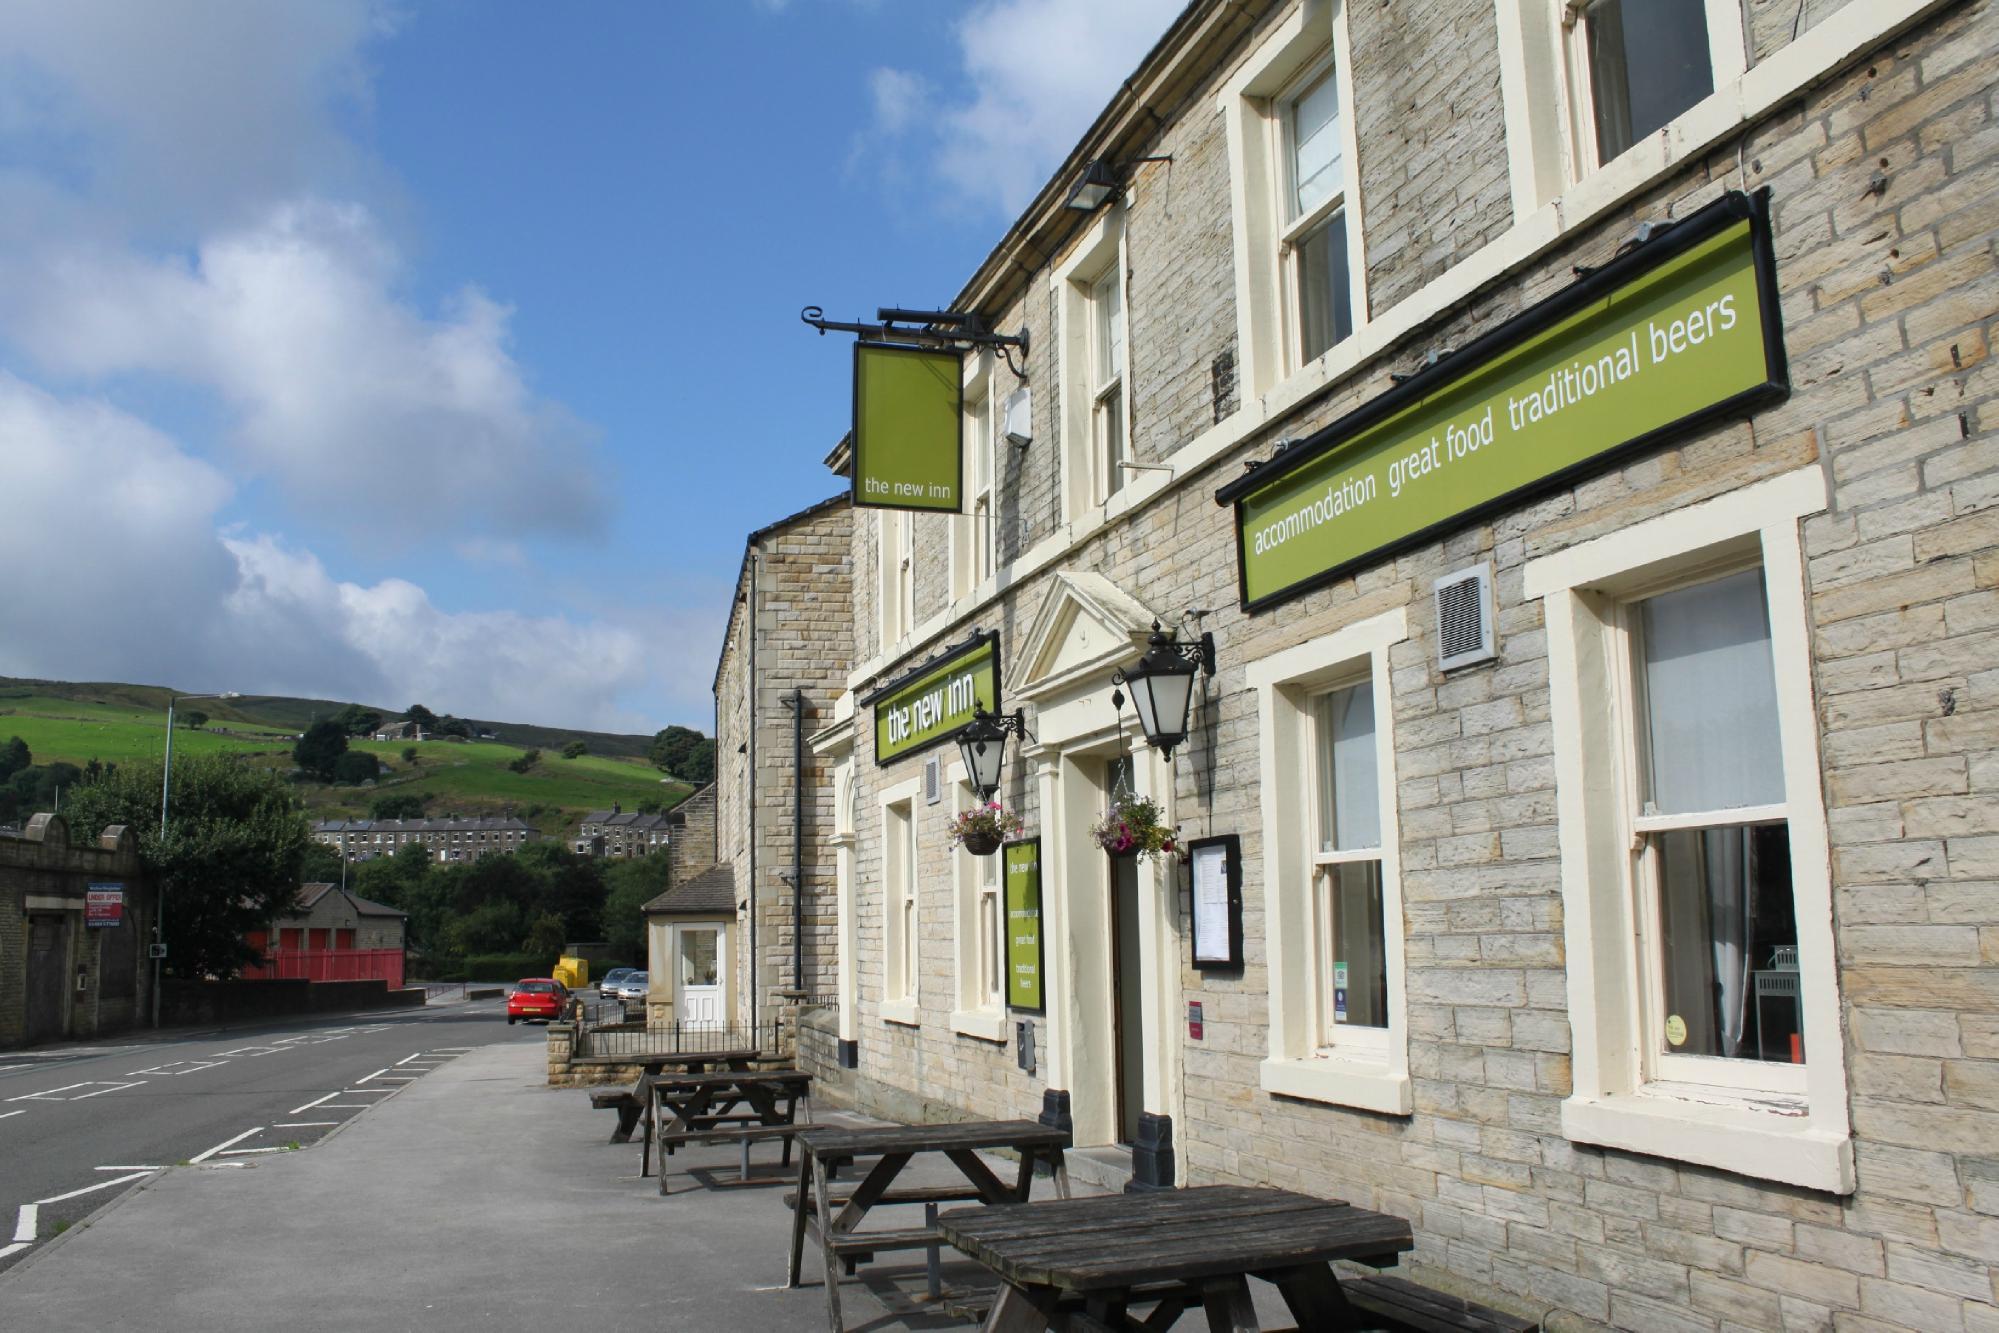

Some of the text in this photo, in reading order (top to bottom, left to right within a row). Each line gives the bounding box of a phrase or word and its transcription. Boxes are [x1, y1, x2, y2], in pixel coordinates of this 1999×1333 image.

[1255, 294, 1737, 555] accommodation great food traditional beers
[865, 476, 951, 499] the new inn
[888, 674, 974, 745] the new inn
